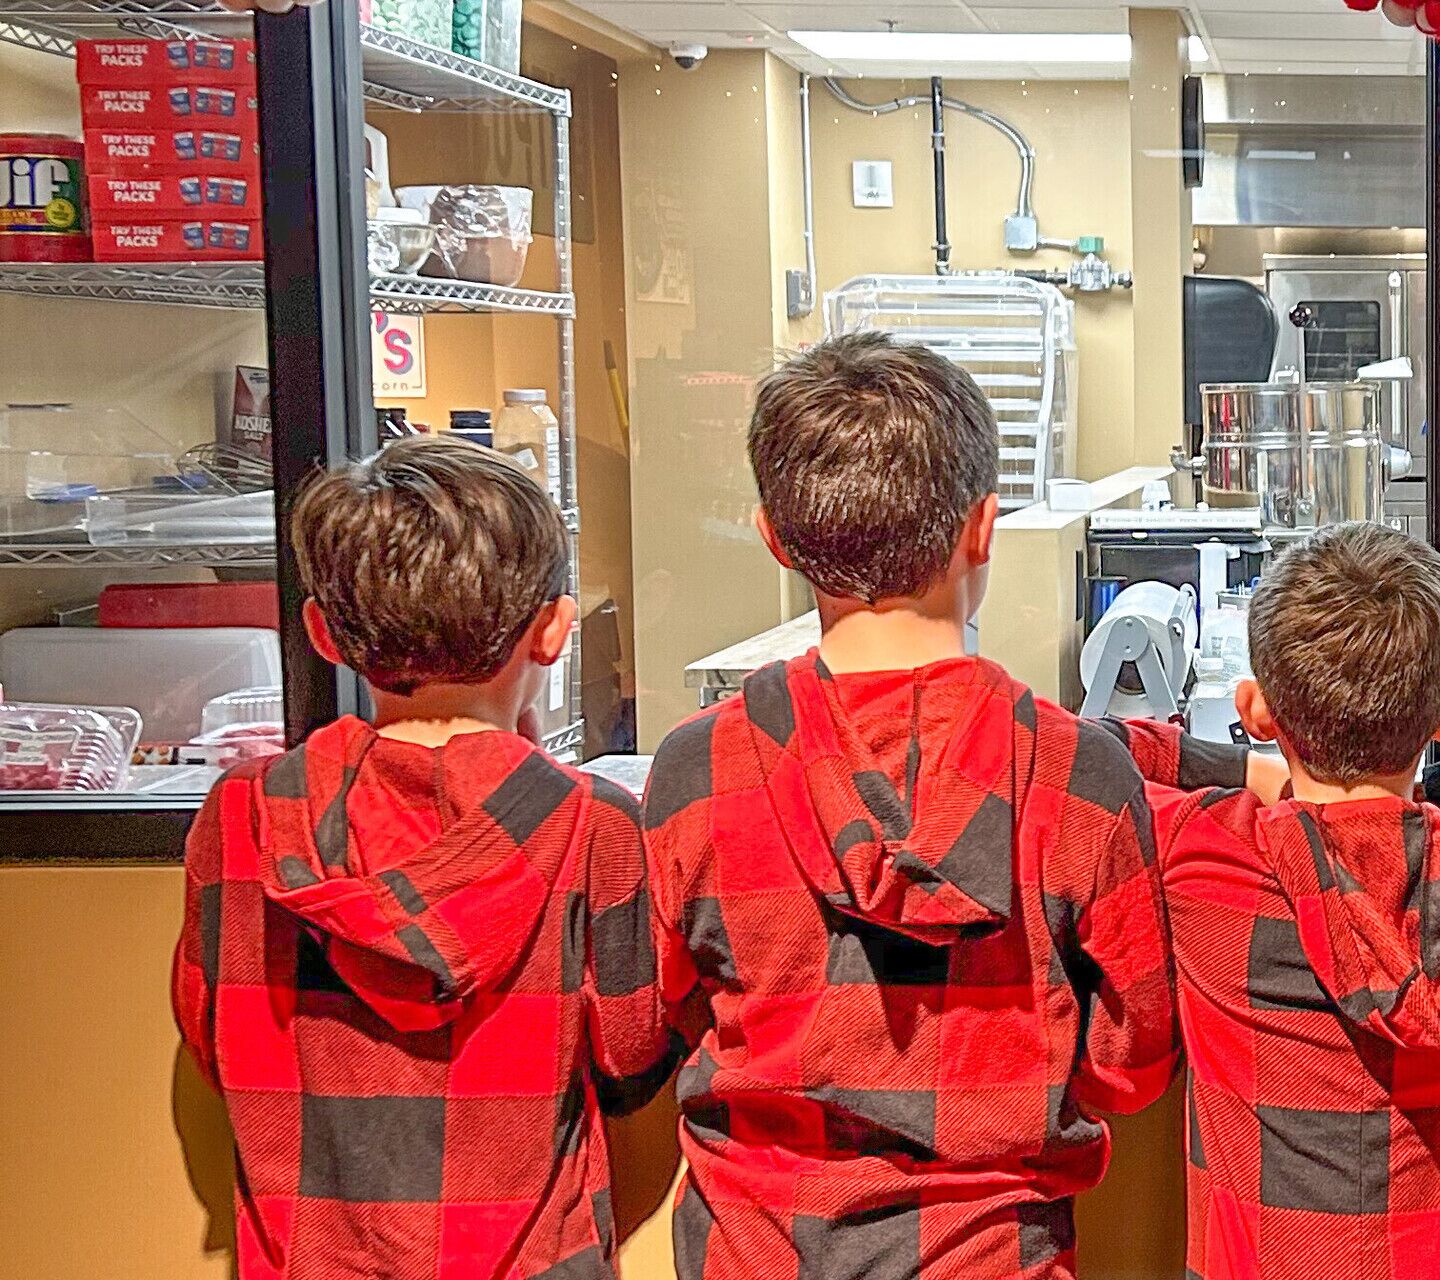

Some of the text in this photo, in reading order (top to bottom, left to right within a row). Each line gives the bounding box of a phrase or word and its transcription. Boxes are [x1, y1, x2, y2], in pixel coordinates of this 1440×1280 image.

[95, 44, 149, 55] TRY THESE
[101, 55, 143, 67] PACKS
[97, 91, 151, 101] TRY THESE
[104, 101, 145, 113] PACKS
[101, 134, 156, 145] TRY THESE
[108, 145, 149, 157] PACKS
[107, 180, 161, 191] TRY THESE
[114, 191, 155, 203] PACKS
[110, 225, 164, 236] TRY THESE
[116, 235, 158, 248] PACKS
[235, 414, 272, 434] KOSHE
